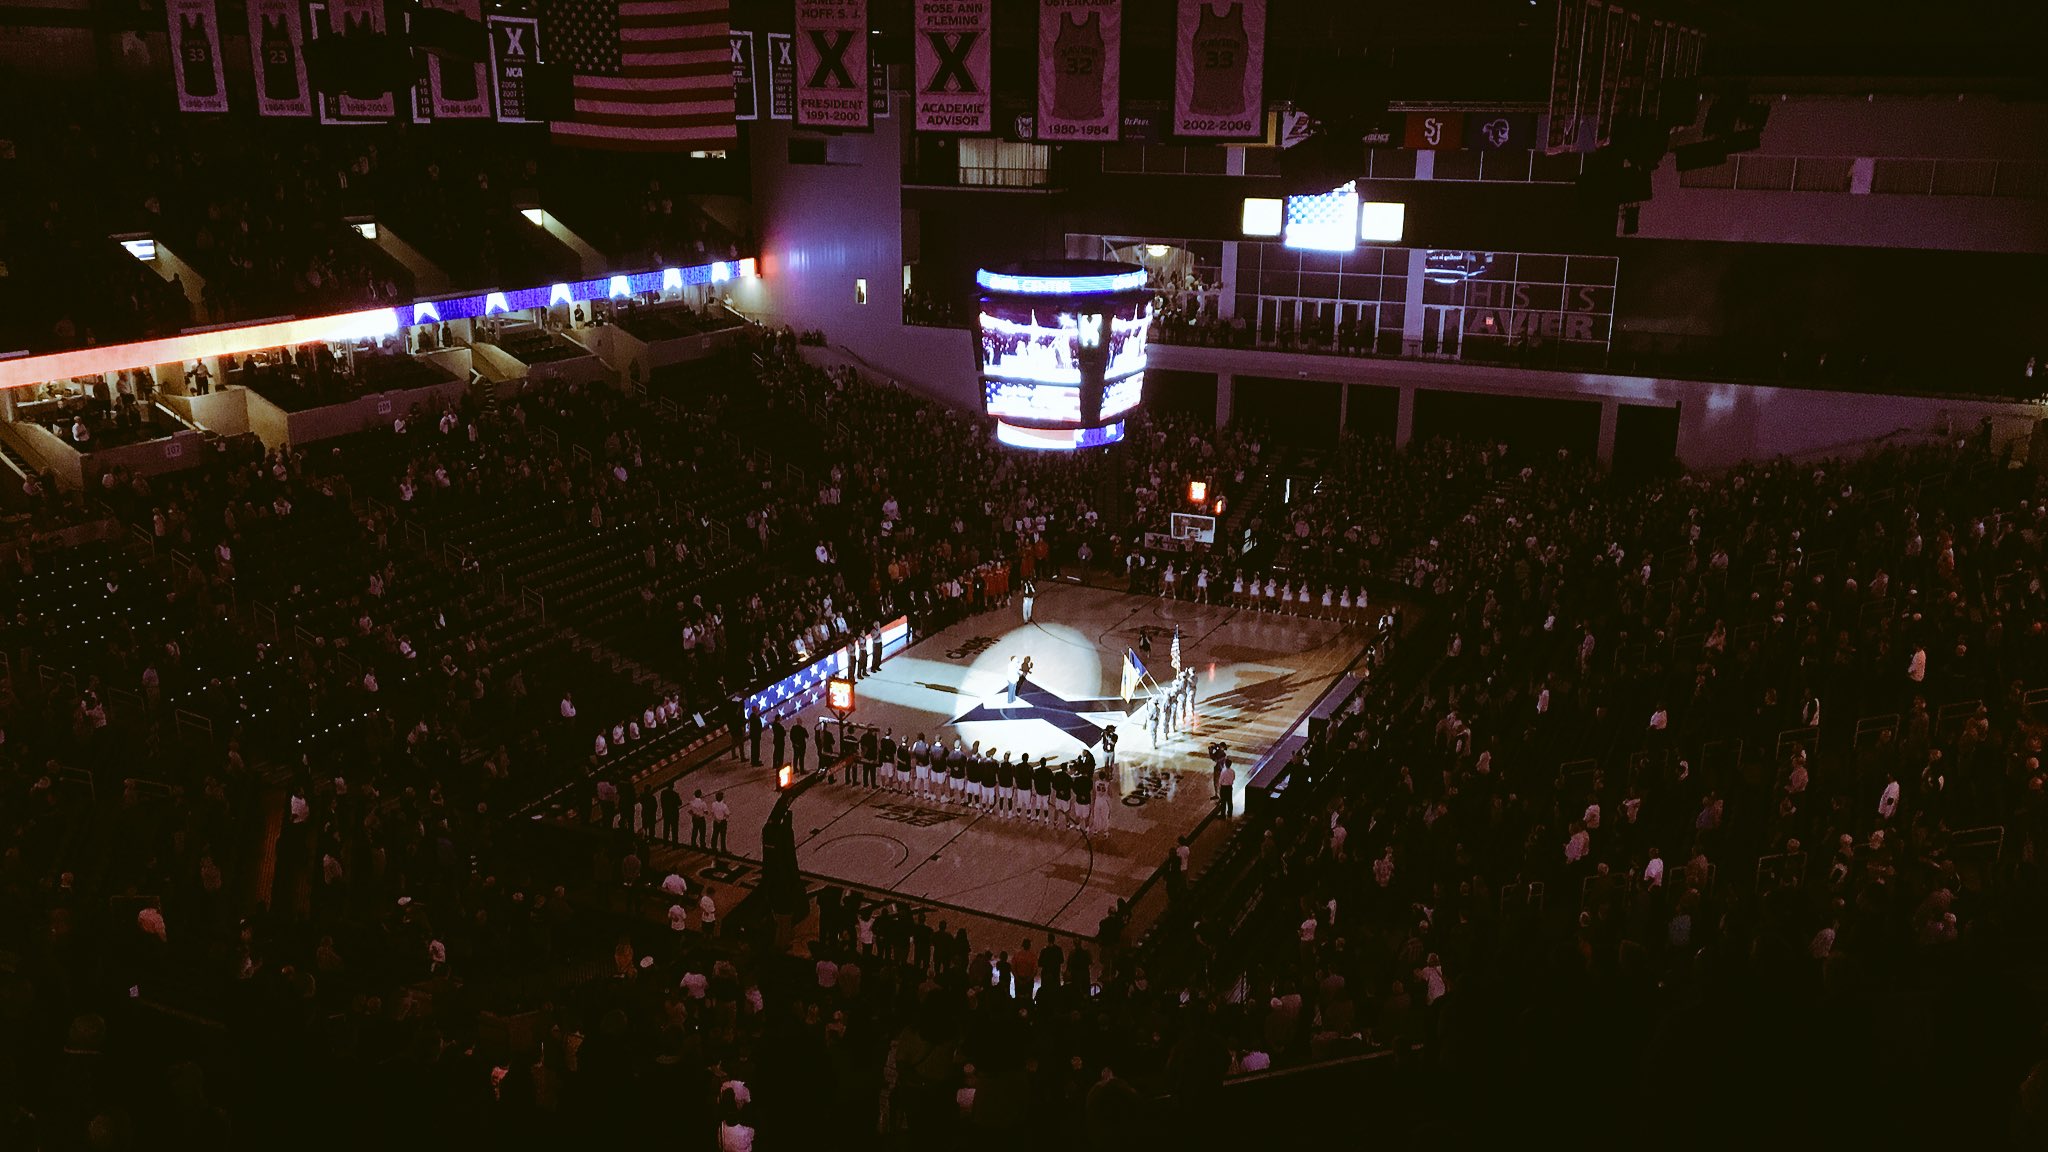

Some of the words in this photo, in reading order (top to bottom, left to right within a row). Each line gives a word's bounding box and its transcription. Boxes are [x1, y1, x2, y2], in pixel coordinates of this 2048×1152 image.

[923, 4, 954, 13] ROSE
[958, 4, 983, 13] ANN
[927, 16, 979, 25] FLEMING
[505, 27, 525, 55] X
[188, 49, 205, 62] 33
[270, 50, 288, 64] 23
[730, 39, 743, 63] X
[779, 42, 791, 65] X
[808, 29, 857, 88] X
[922, 30, 984, 94] X
[1205, 51, 1233, 68] 33
[1066, 57, 1092, 73] 32
[505, 67, 524, 77] NCA
[801, 99, 863, 110] PRESIDENT
[921, 103, 984, 114] ACADEMIC
[806, 111, 860, 121] 1991-2000
[927, 116, 979, 126] ADVISOR
[1048, 124, 1109, 135] 1980-1984
[1183, 120, 1251, 131] 2002-2006
